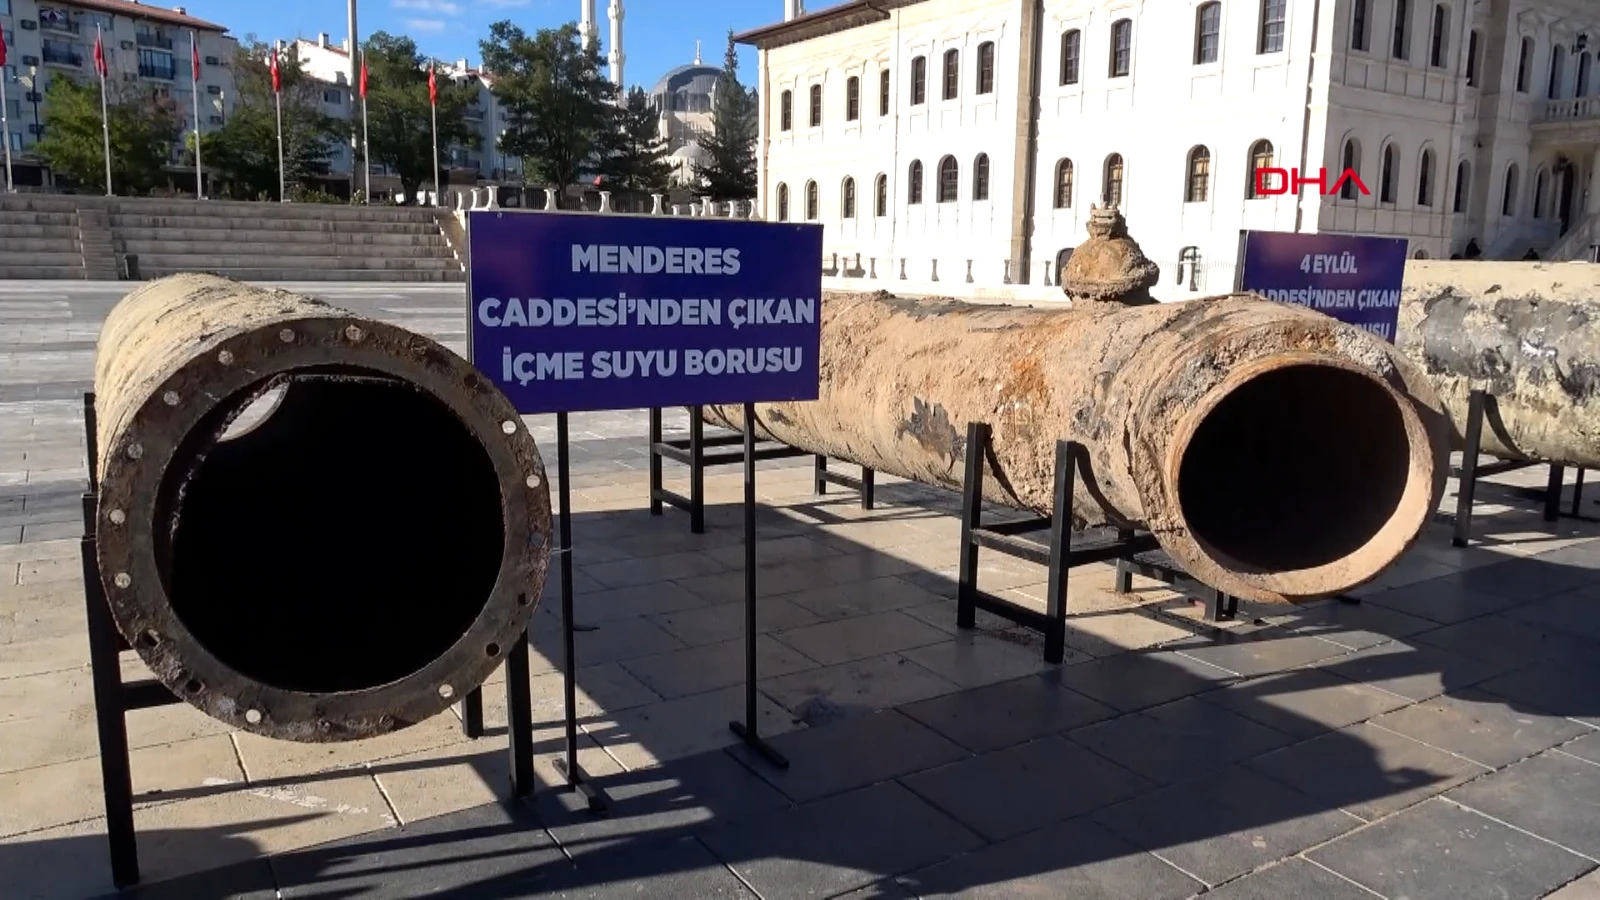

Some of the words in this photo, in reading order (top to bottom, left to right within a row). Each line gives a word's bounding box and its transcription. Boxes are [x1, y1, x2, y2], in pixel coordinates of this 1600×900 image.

[572, 244, 741, 275] MENDERES
[1300, 254, 1311, 273] 4
[1313, 251, 1358, 274] EYLÜL
[478, 292, 722, 327] CADDESİ'NDEN
[727, 298, 815, 329] ÇIKAN
[1248, 286, 1354, 308] DDESİ'NDEN
[1357, 289, 1400, 310] ÇIKAN
[502, 346, 584, 387] İÇME
[591, 350, 677, 379] SUYU
[684, 346, 803, 376] BORUSU
